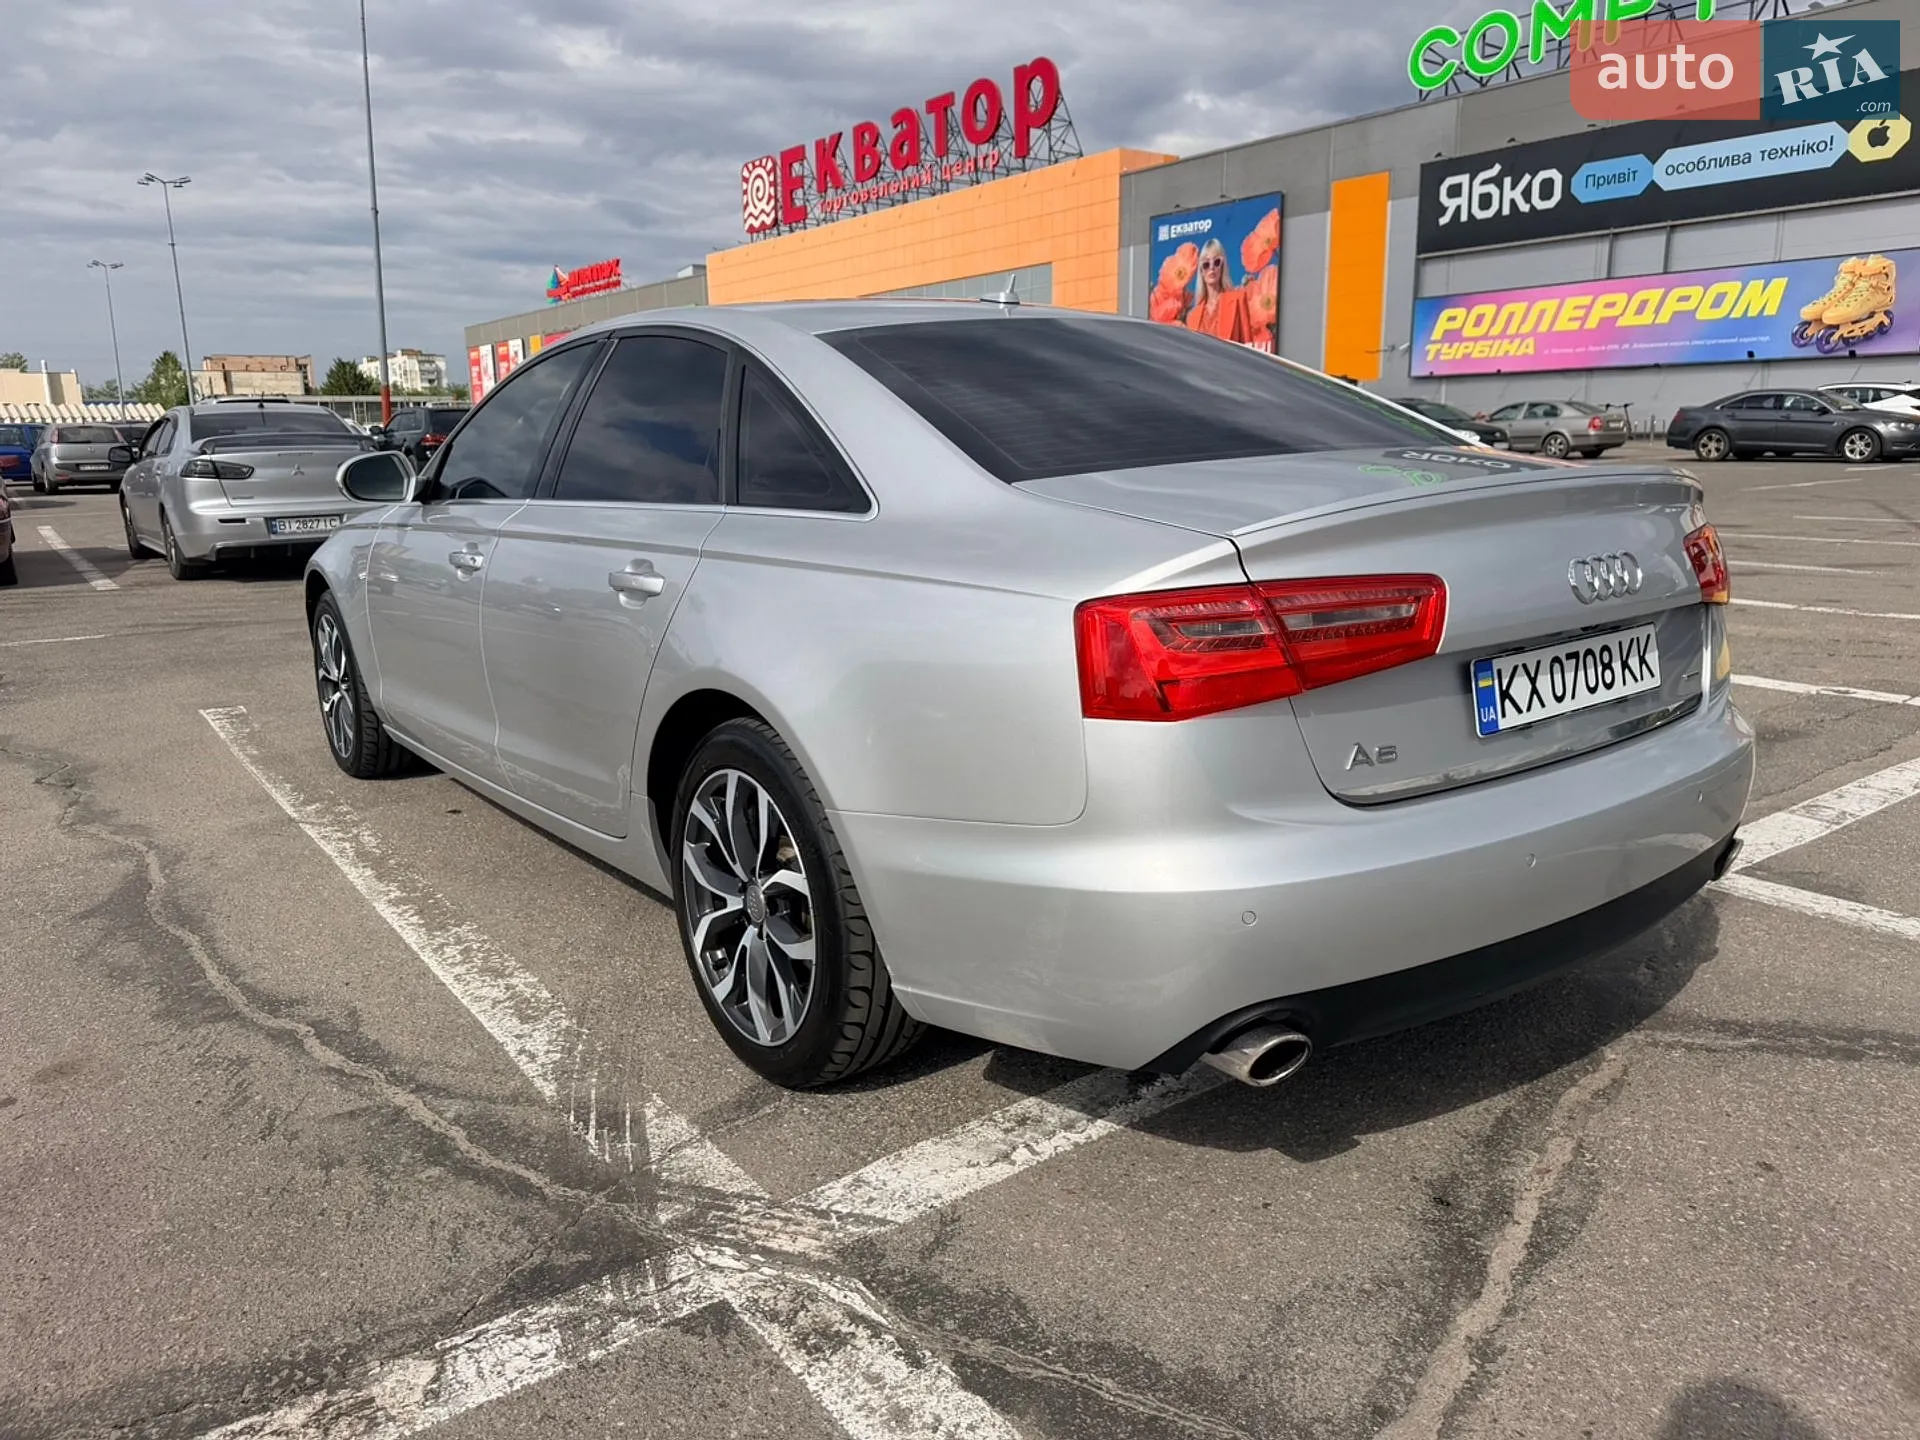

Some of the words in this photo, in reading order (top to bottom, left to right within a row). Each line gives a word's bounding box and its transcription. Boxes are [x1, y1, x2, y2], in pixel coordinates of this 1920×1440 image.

[818, 162, 935, 213] торговельний
[942, 149, 1000, 182] центр
[1584, 167, 1639, 189] Привіт
[1664, 150, 1752, 176] особлива
[1759, 136, 1835, 162] техніко!
[1438, 163, 1563, 226] Ябко
[1430, 277, 1789, 341] РОЛЛЕРДРОМ
[1425, 336, 1535, 361] ТУРБІНА
[278, 520, 292, 531] BI
[295, 518, 321, 530] 2827
[1480, 706, 1496, 722] UA
[1345, 742, 1398, 771] A6
